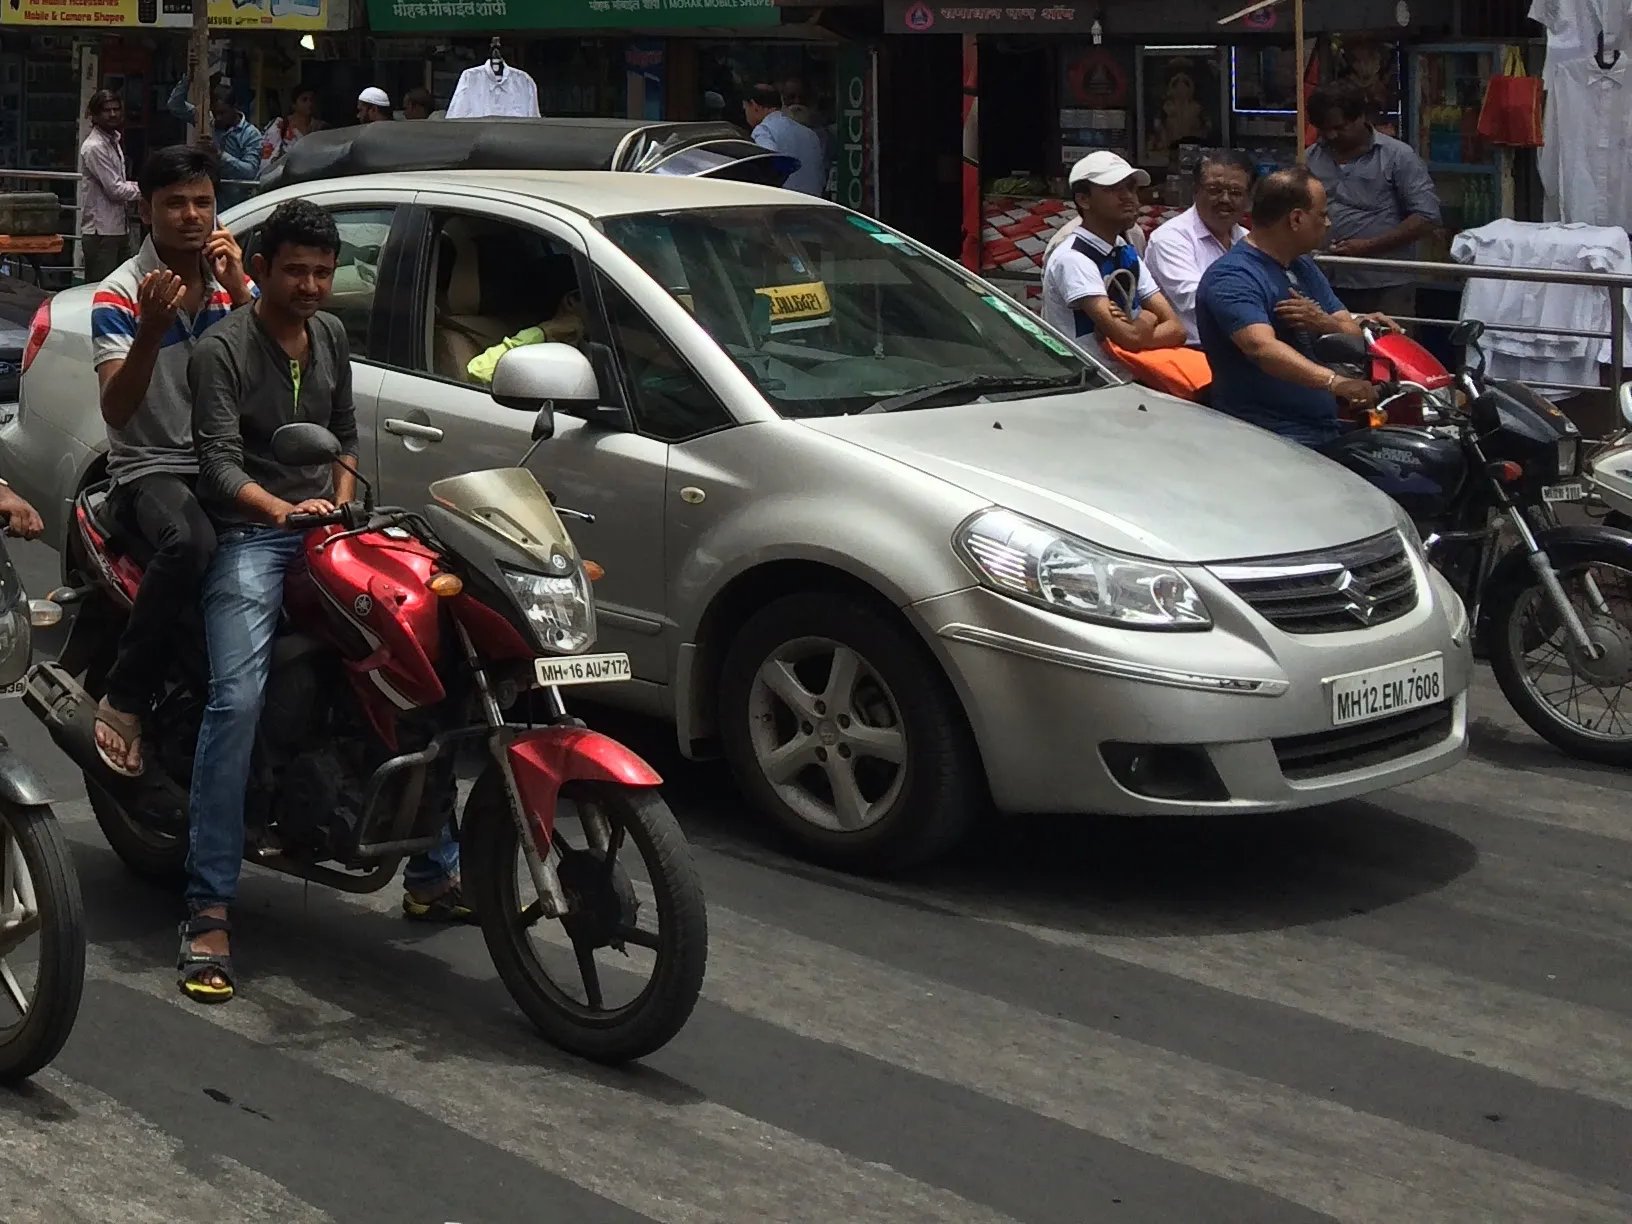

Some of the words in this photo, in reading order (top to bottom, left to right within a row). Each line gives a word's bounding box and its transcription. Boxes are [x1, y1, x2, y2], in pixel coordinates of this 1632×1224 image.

[24, 10, 49, 21] Mobile
[52, 11, 58, 20] &
[94, 12, 125, 25] Shopee
